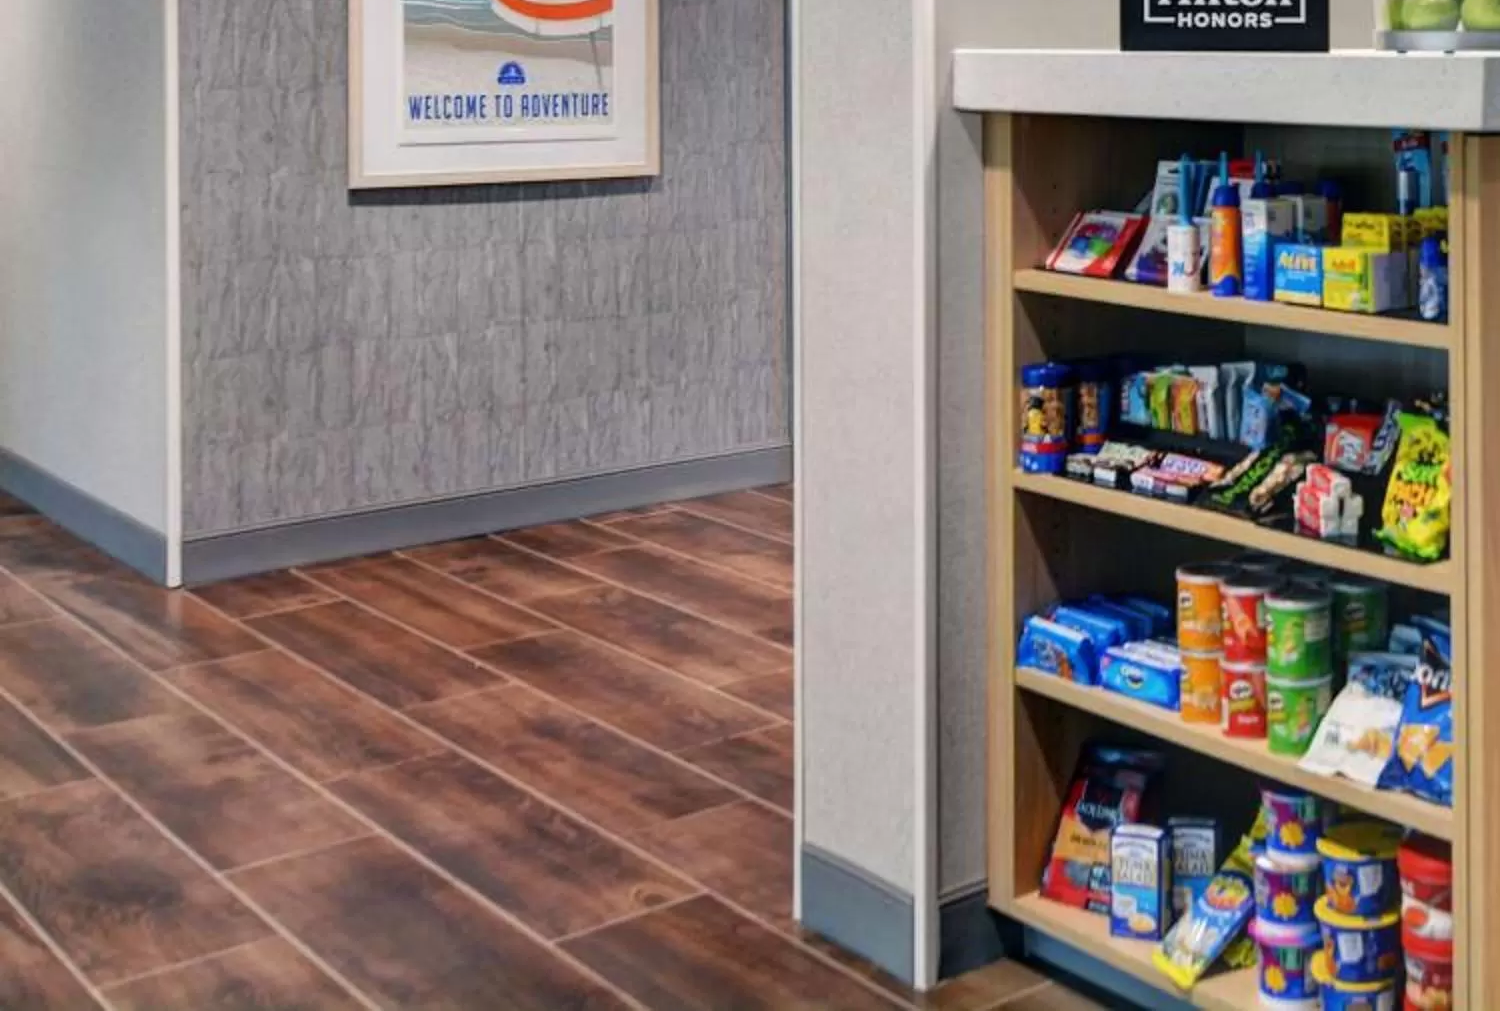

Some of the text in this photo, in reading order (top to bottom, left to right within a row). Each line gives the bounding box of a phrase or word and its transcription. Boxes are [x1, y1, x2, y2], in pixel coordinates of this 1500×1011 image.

[1177, 12, 1274, 29] HONORS
[408, 92, 610, 121] WELCOME TO ADVENTURE
